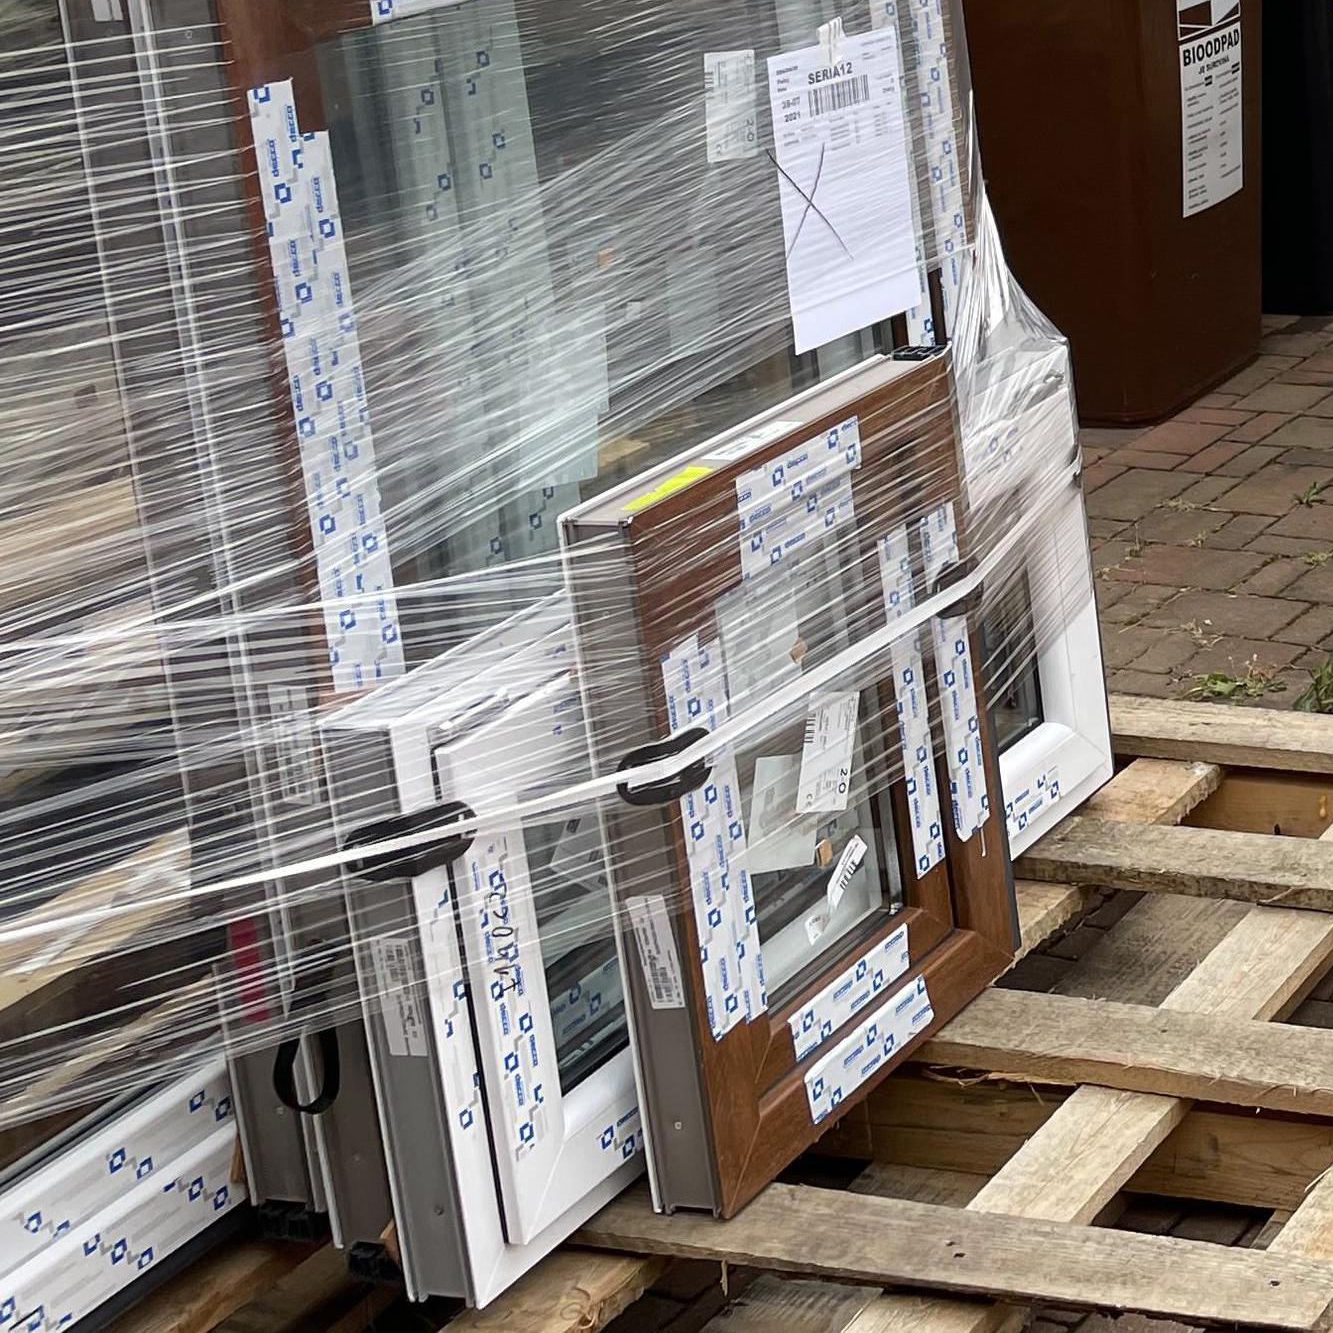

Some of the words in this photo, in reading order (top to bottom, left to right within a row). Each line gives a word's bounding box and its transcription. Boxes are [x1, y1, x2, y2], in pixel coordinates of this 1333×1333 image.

[1183, 28, 1240, 66] BIOODPAD
[808, 62, 853, 85] SERIA12
[285, 105, 297, 142] decco
[267, 138, 279, 177] decco
[312, 177, 324, 213] decco
[289, 239, 301, 277] decco
